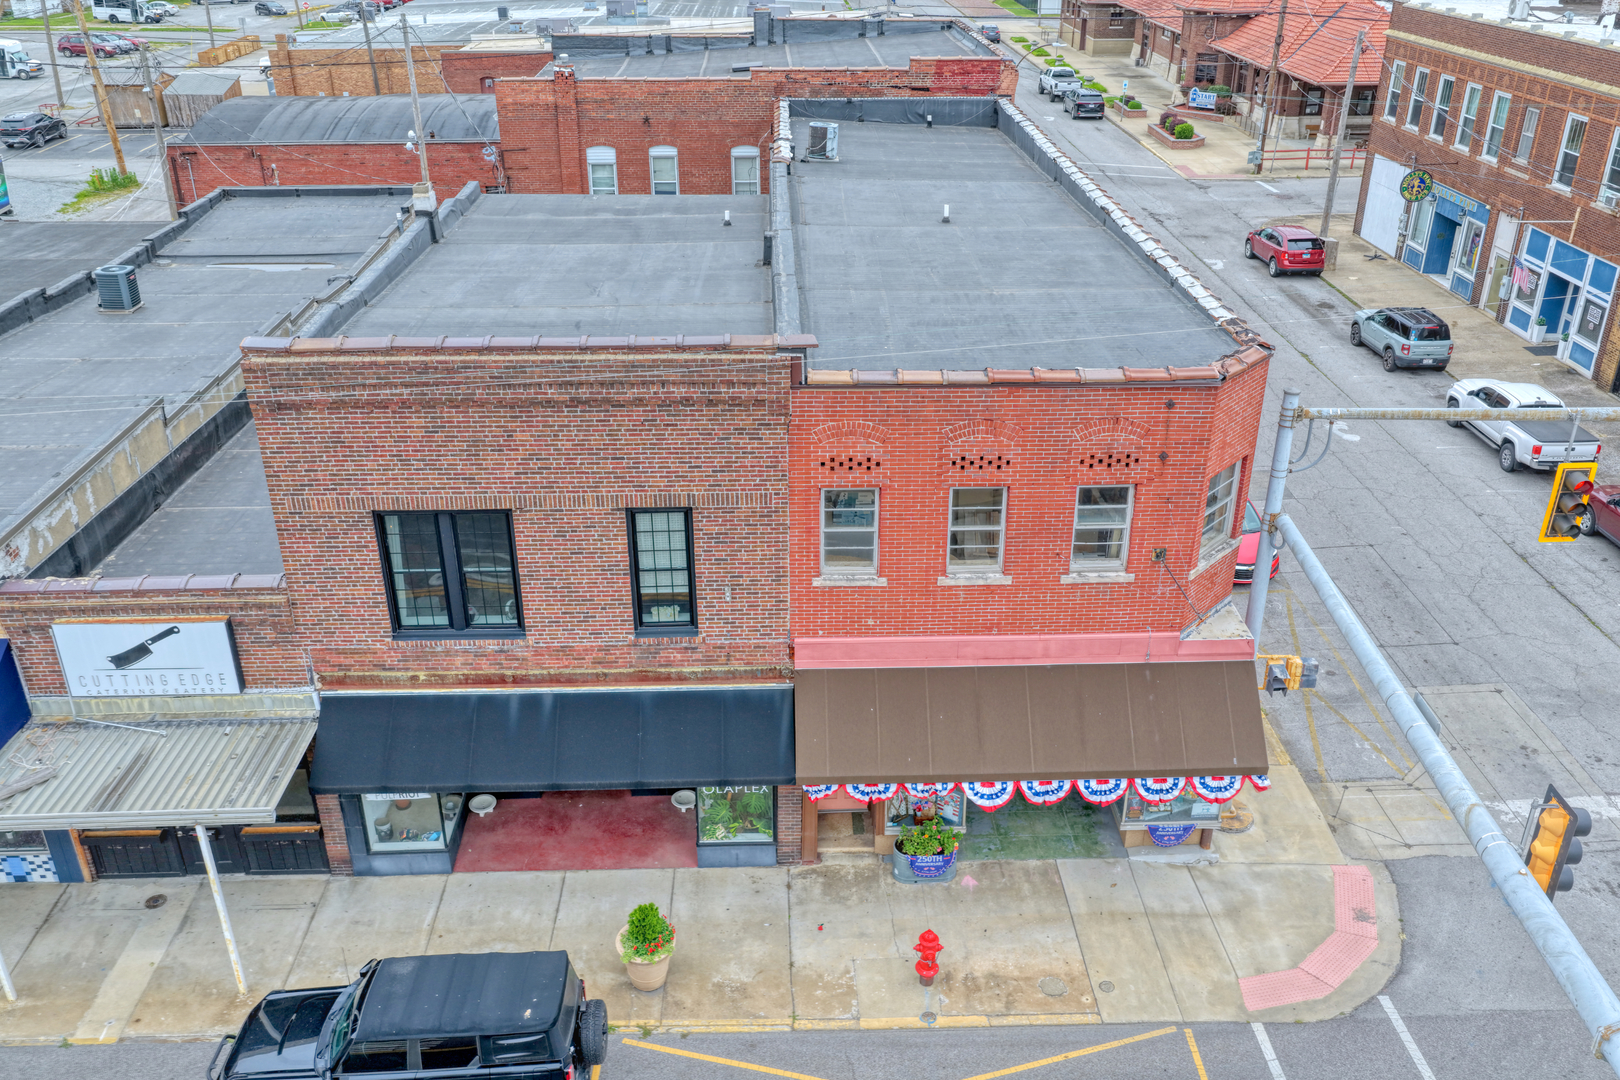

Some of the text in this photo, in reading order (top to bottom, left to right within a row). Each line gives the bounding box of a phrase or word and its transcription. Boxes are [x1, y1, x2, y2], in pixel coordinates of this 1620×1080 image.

[1197, 93, 1216, 101] START
[1458, 196, 1476, 211] PINT
[78, 672, 227, 688] CUTTING EDGE
[86, 687, 156, 696] CATERING
[703, 785, 769, 794] OLAPLEX
